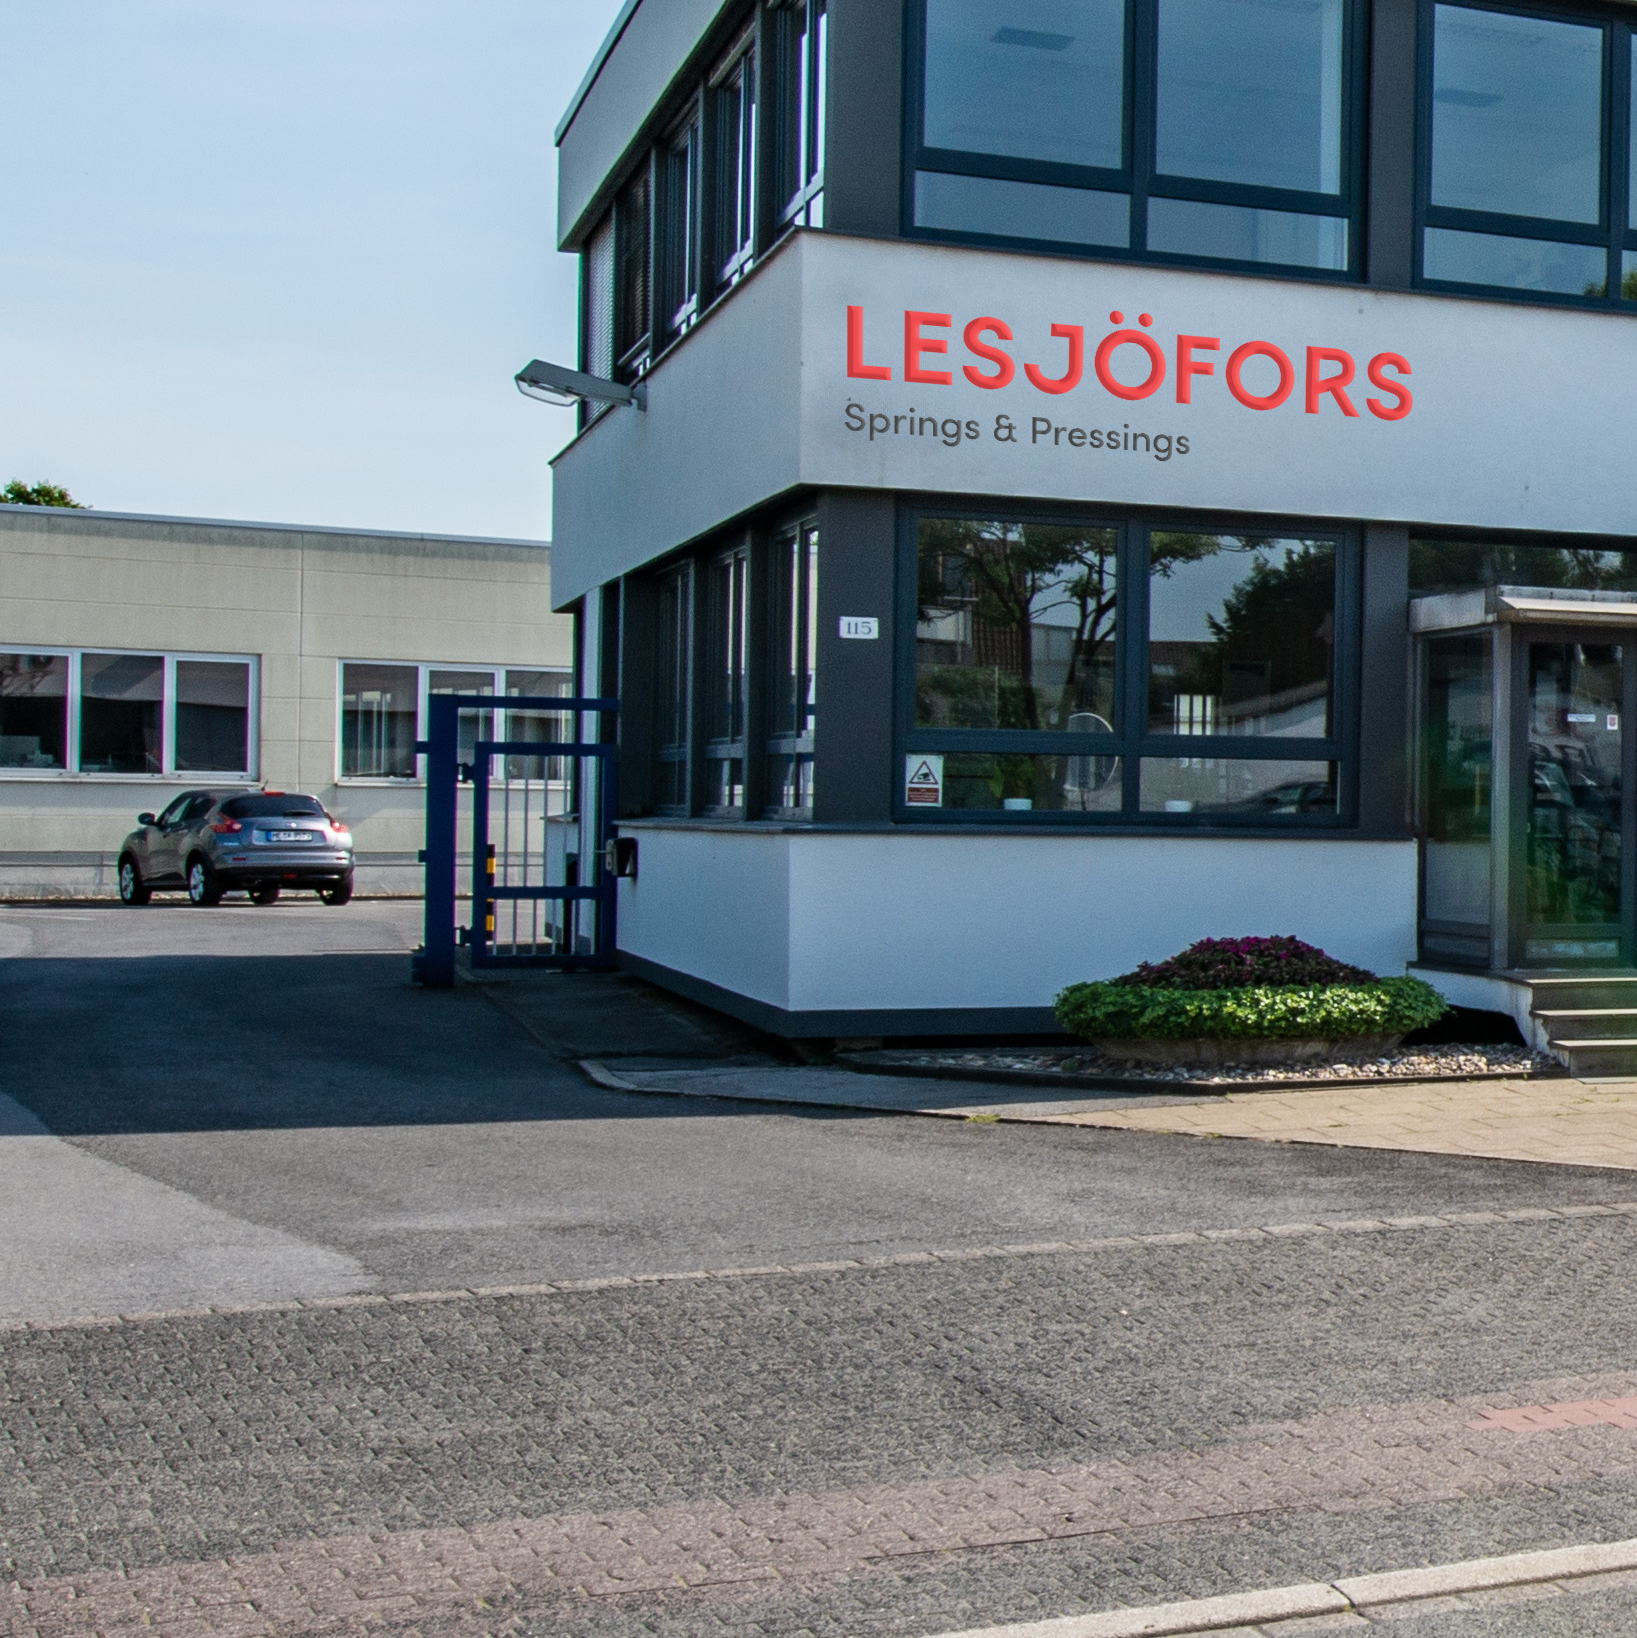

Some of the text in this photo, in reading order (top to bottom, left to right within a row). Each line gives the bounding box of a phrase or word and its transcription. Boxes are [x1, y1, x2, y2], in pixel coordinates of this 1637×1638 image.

[846, 304, 1413, 421] LESJÖFORS
[844, 403, 1190, 462] Springs & Pressings
[847, 621, 872, 635] 115
